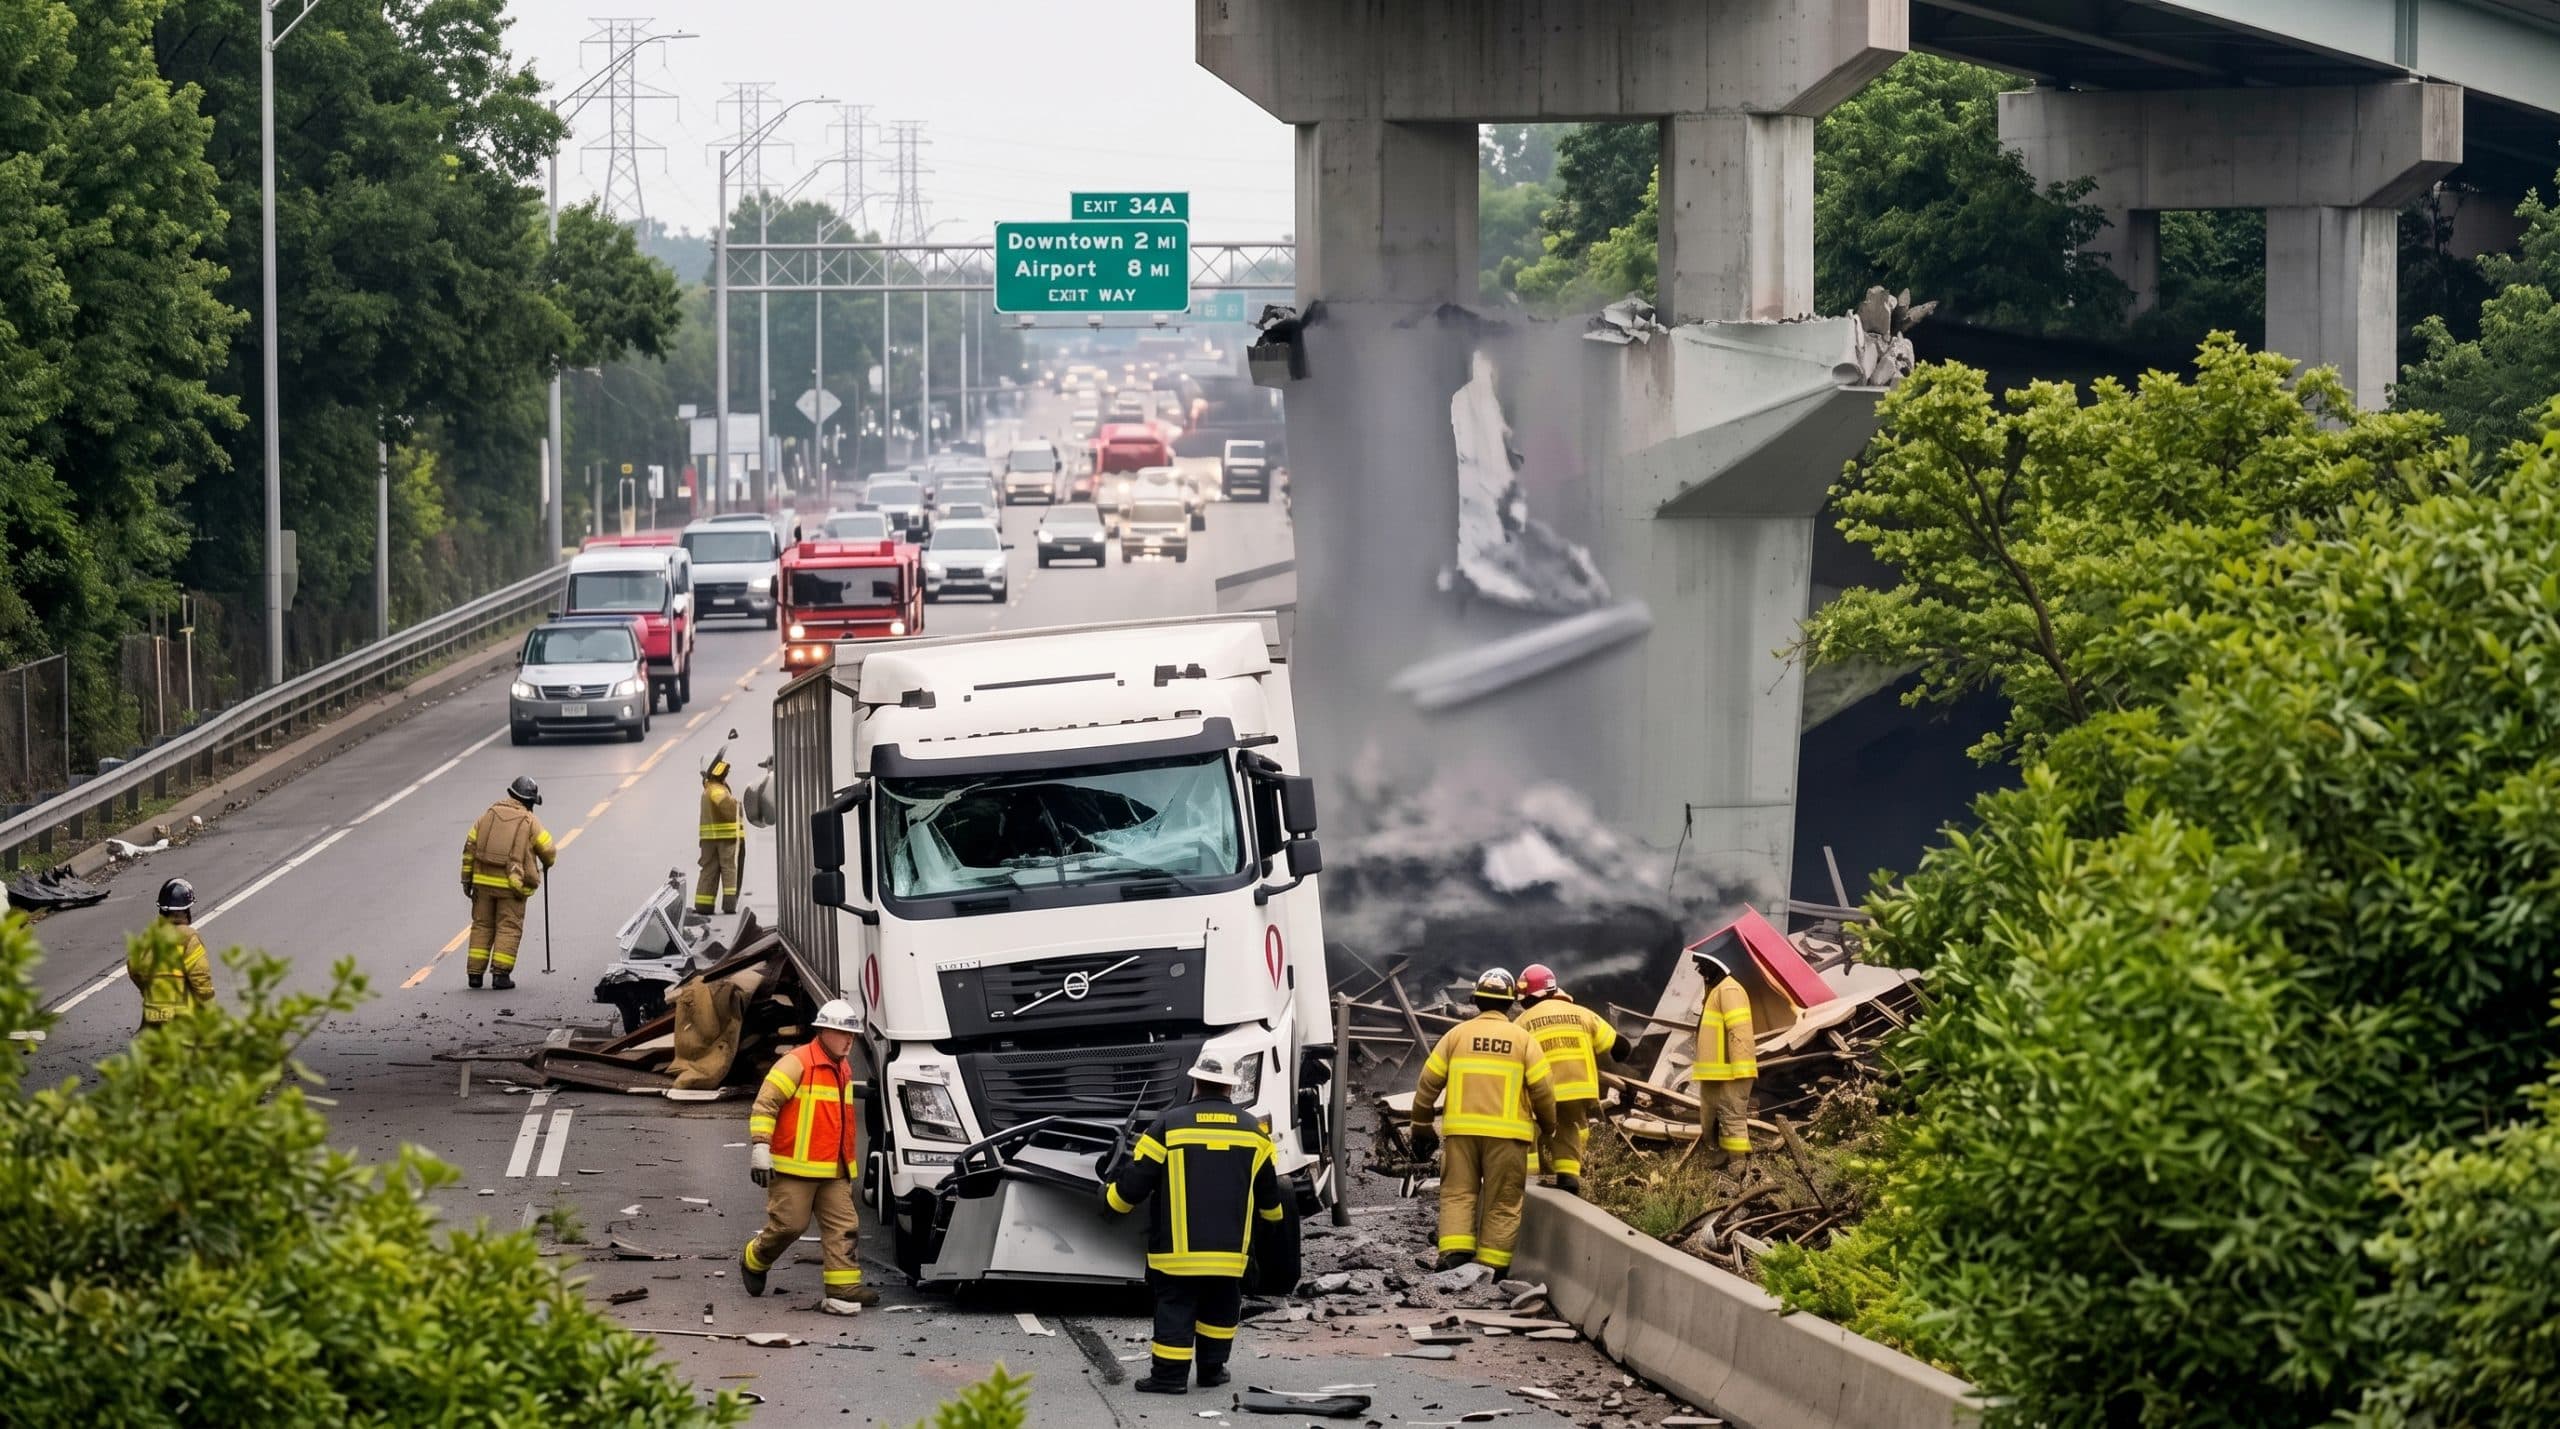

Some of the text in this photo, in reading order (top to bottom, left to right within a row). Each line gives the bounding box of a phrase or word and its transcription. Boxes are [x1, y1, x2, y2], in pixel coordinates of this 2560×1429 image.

[1083, 197, 1176, 215] EXIT 34A
[1008, 231, 1176, 250] Downtown 2 MI
[1014, 258, 1169, 281] Airport 8 MI
[1098, 288, 1136, 302] WAY
